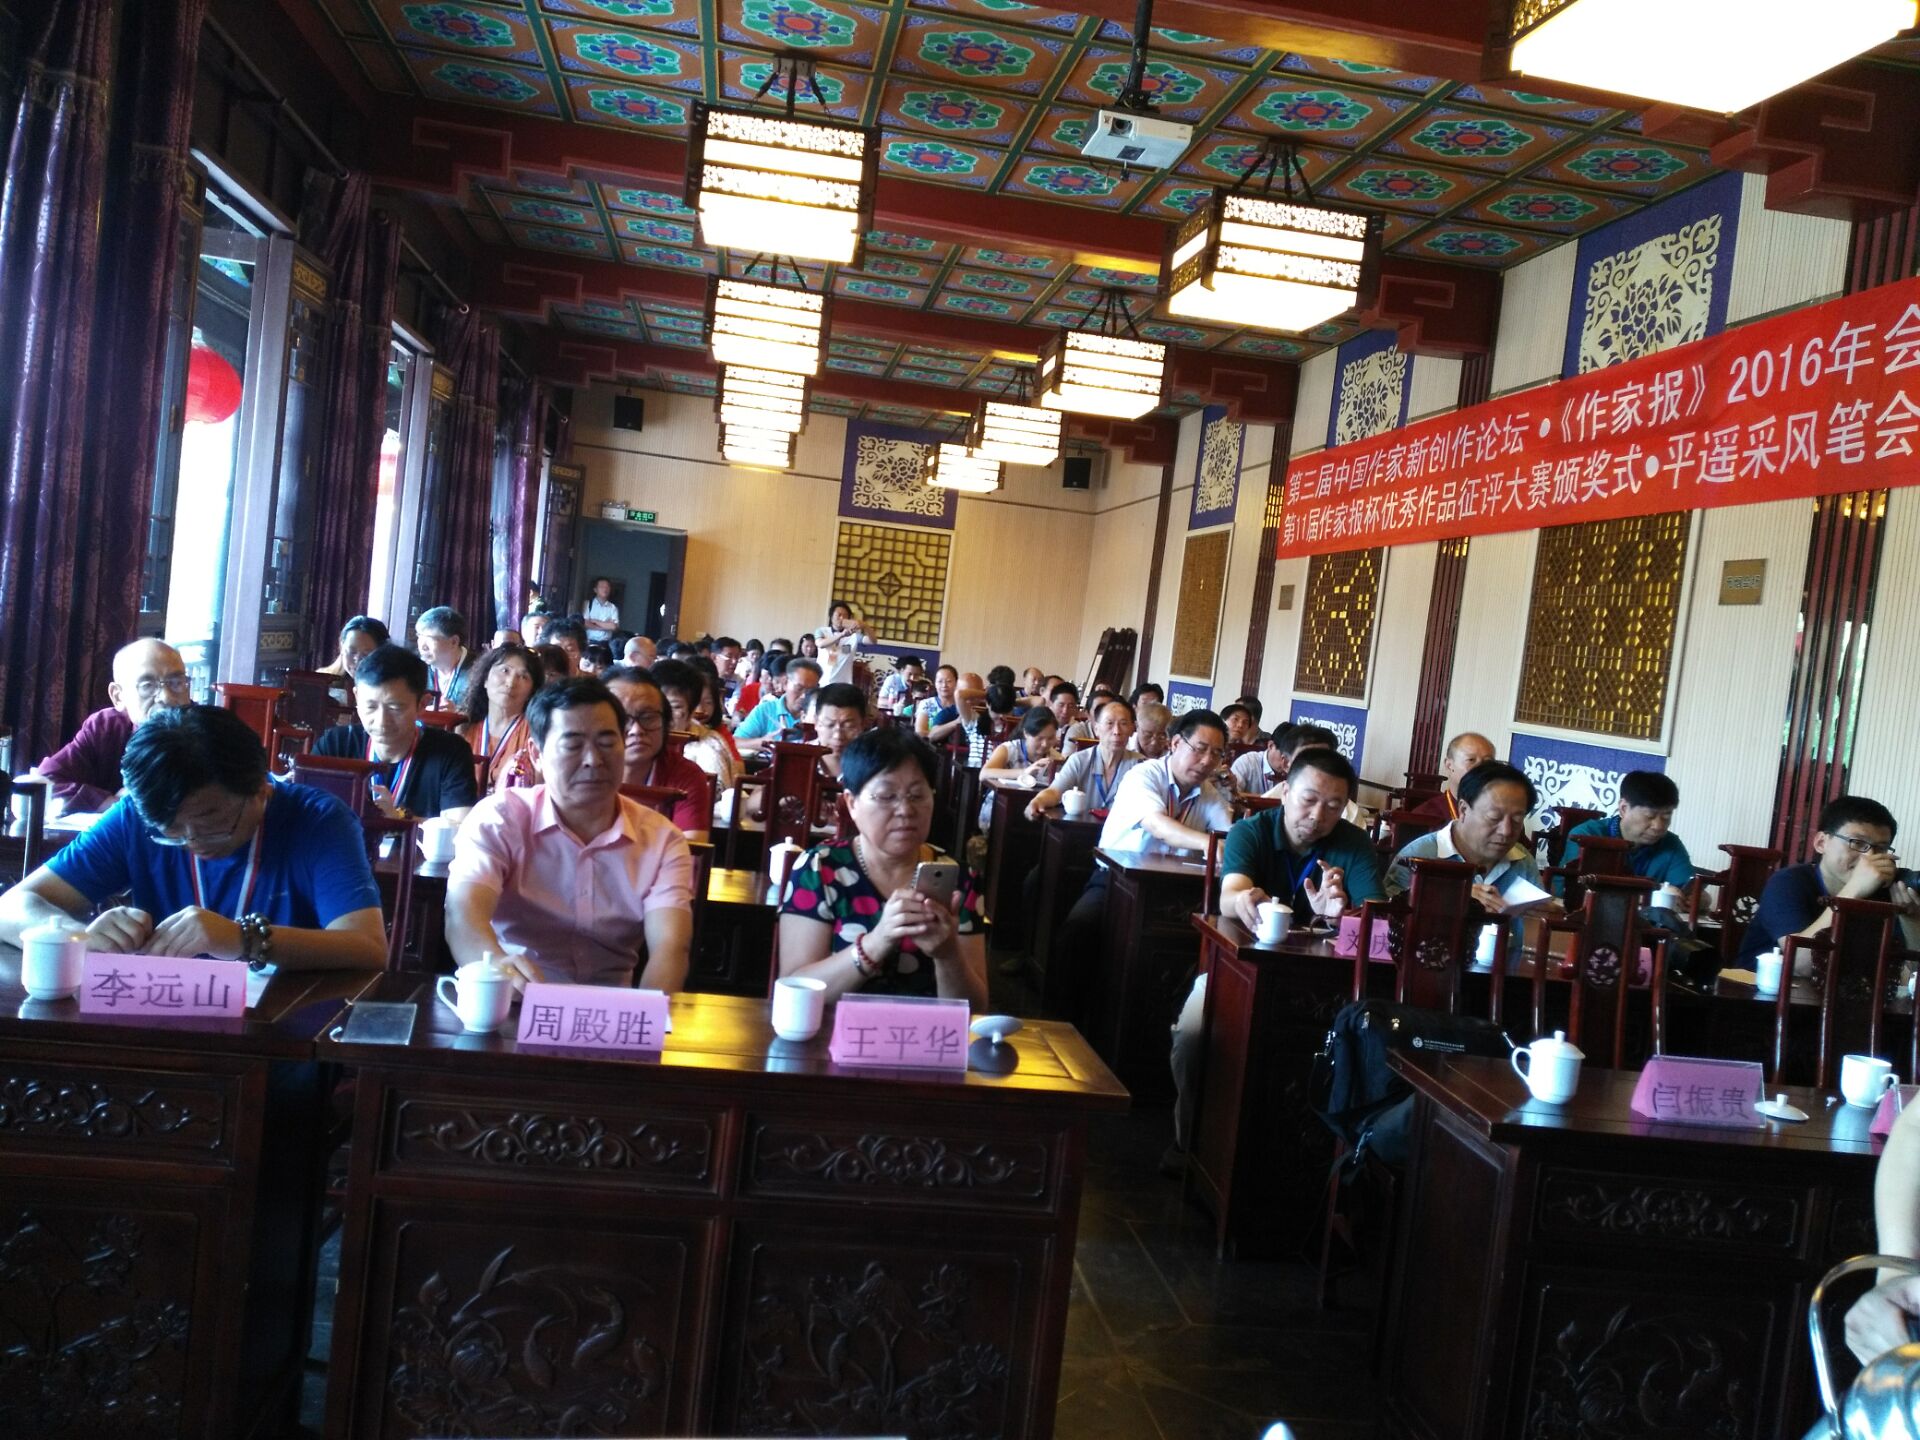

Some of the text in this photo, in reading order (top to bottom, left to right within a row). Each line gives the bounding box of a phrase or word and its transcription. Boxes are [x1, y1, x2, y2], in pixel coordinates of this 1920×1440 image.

[91, 968, 231, 1009] 李远山
[524, 1004, 653, 1046] 周殿胜
[842, 1025, 960, 1062] 王平华
[1652, 1082, 1749, 1119] 闫振贵
